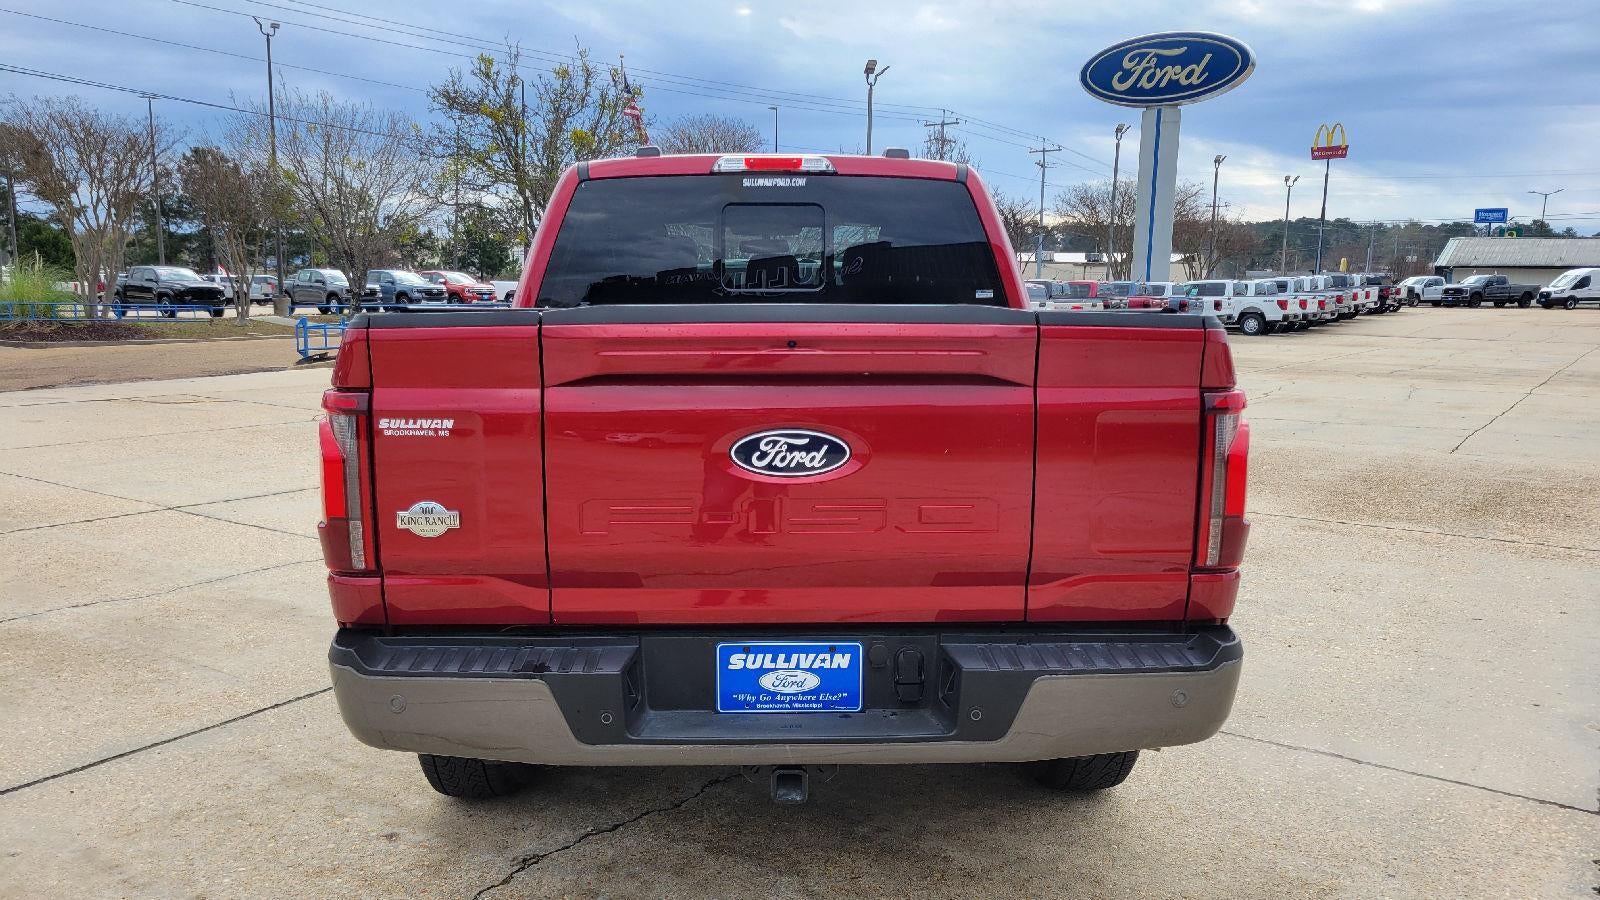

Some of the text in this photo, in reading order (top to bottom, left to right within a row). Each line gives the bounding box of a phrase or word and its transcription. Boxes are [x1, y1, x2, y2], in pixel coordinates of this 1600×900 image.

[1111, 46, 1213, 92] Ford
[742, 177, 807, 187] SULLIVANFORD.COM
[379, 418, 454, 429] SULLIVAN
[383, 429, 436, 437] BROOKHAVEN,
[751, 436, 829, 467] Ford
[400, 514, 457, 526] KING RANCH
[728, 653, 851, 669] SULLIVAN
[772, 674, 806, 689] Ford
[759, 693, 772, 701] Go
[775, 693, 817, 703] Anywhere
